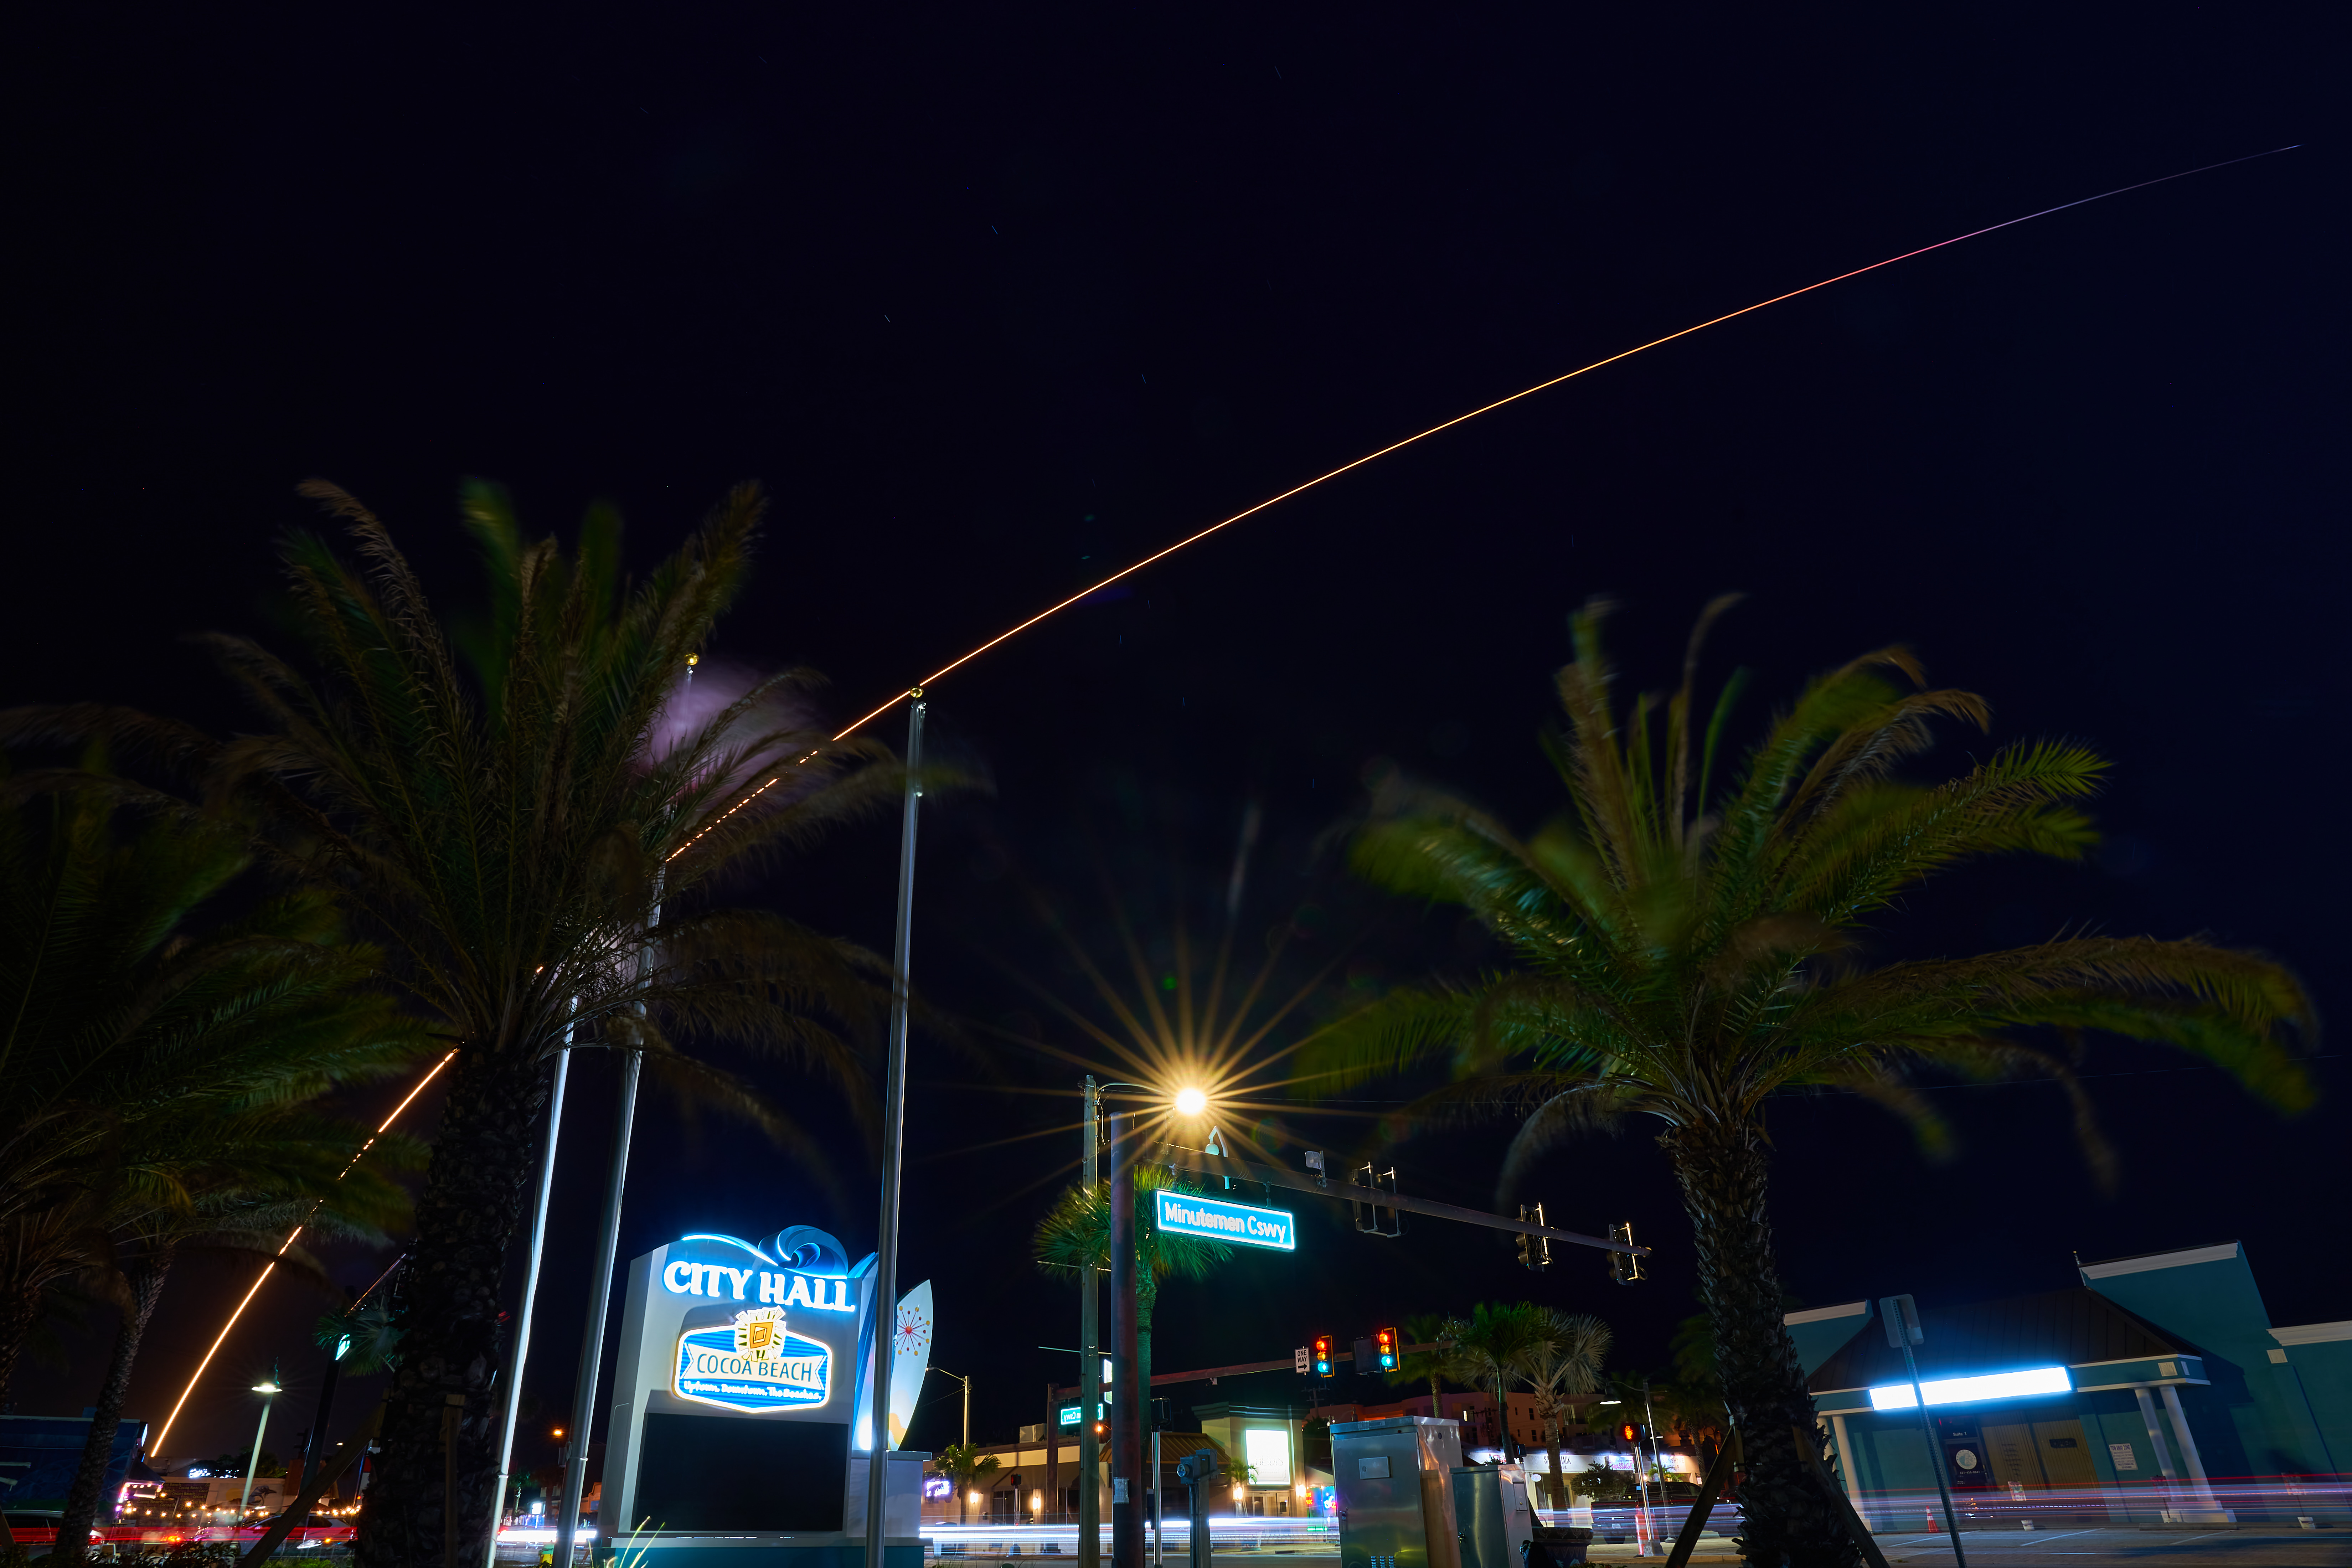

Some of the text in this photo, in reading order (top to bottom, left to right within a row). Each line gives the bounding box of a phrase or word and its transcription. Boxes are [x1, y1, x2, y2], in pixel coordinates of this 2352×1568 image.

[1165, 1202, 1286, 1243] Minutemen Cswy
[663, 1261, 855, 1312] CITY HALL
[697, 1353, 812, 1382] COCOA BEACH
[767, 1386, 783, 1397] The
[1561, 1456, 1571, 1464] HACK
